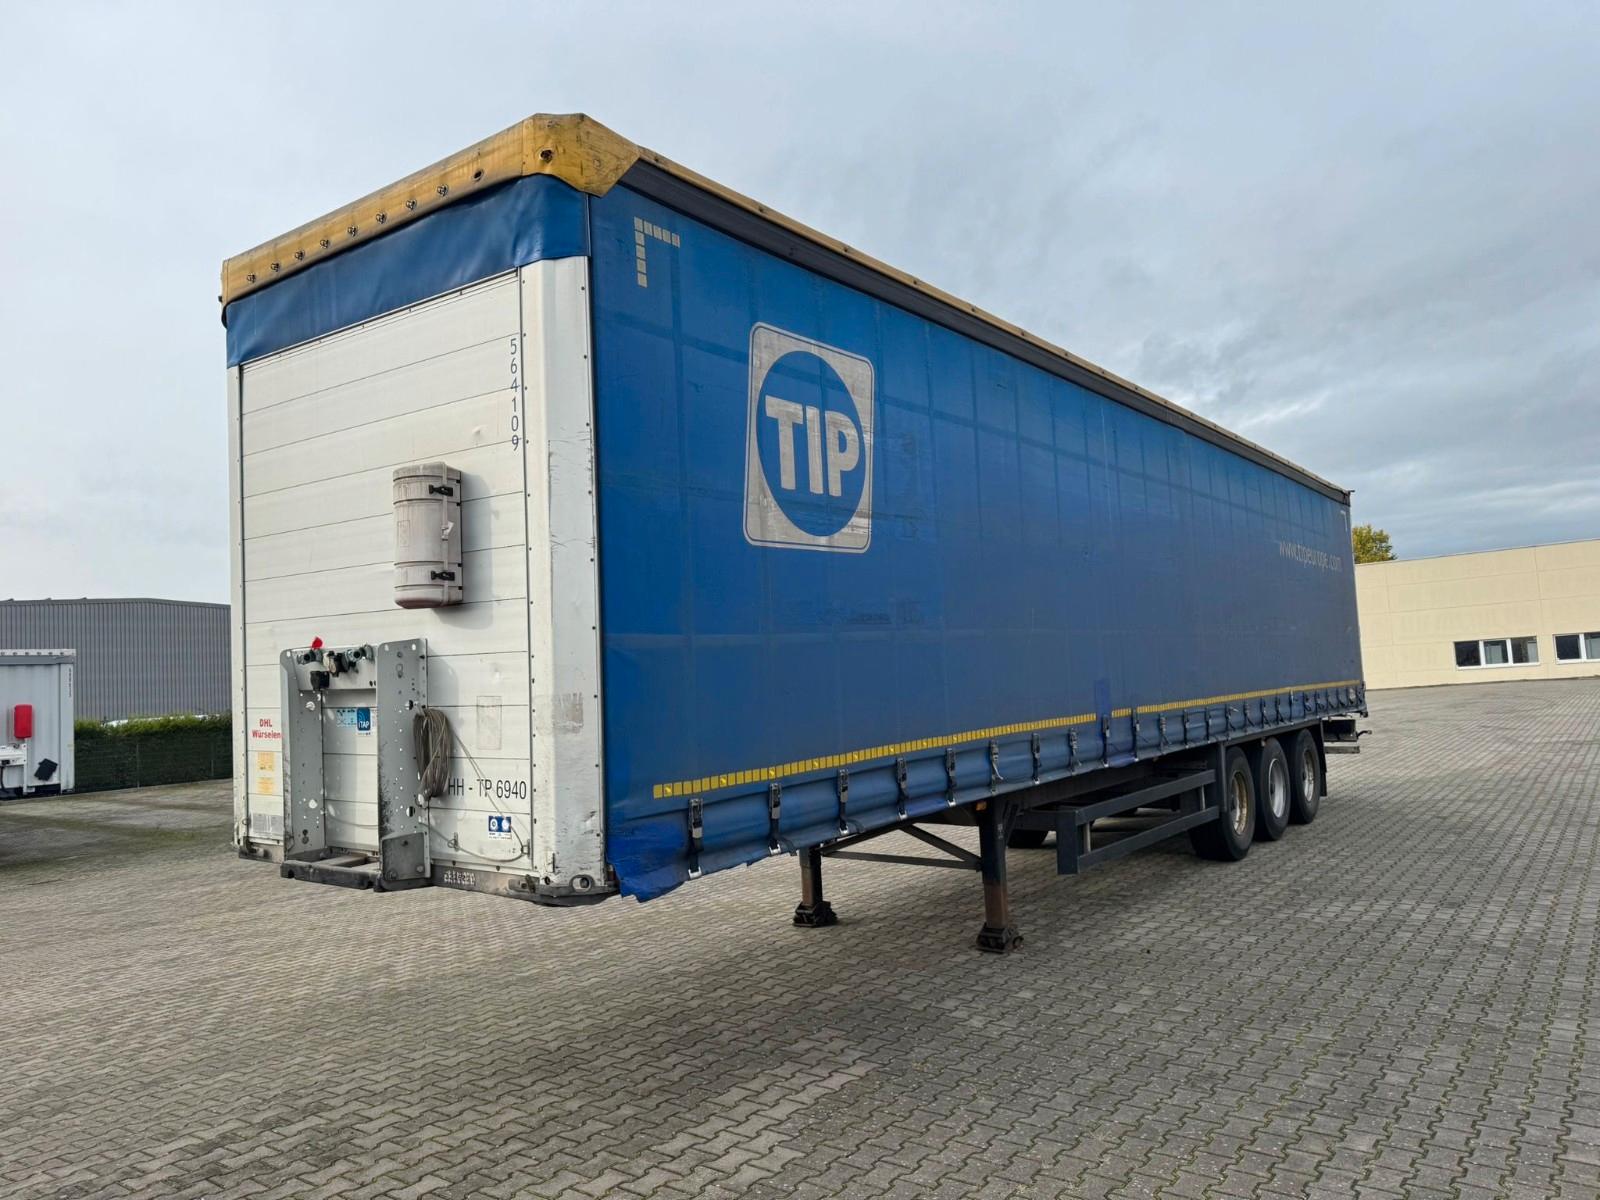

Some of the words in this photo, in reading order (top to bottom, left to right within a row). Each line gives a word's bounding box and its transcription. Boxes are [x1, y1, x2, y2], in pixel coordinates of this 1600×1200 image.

[510, 337, 519, 452] 564109
[765, 395, 860, 497] TIP
[259, 718, 273, 728] DHL
[448, 778, 465, 796] HH
[476, 778, 493, 798] TP
[496, 780, 527, 800] 6940
